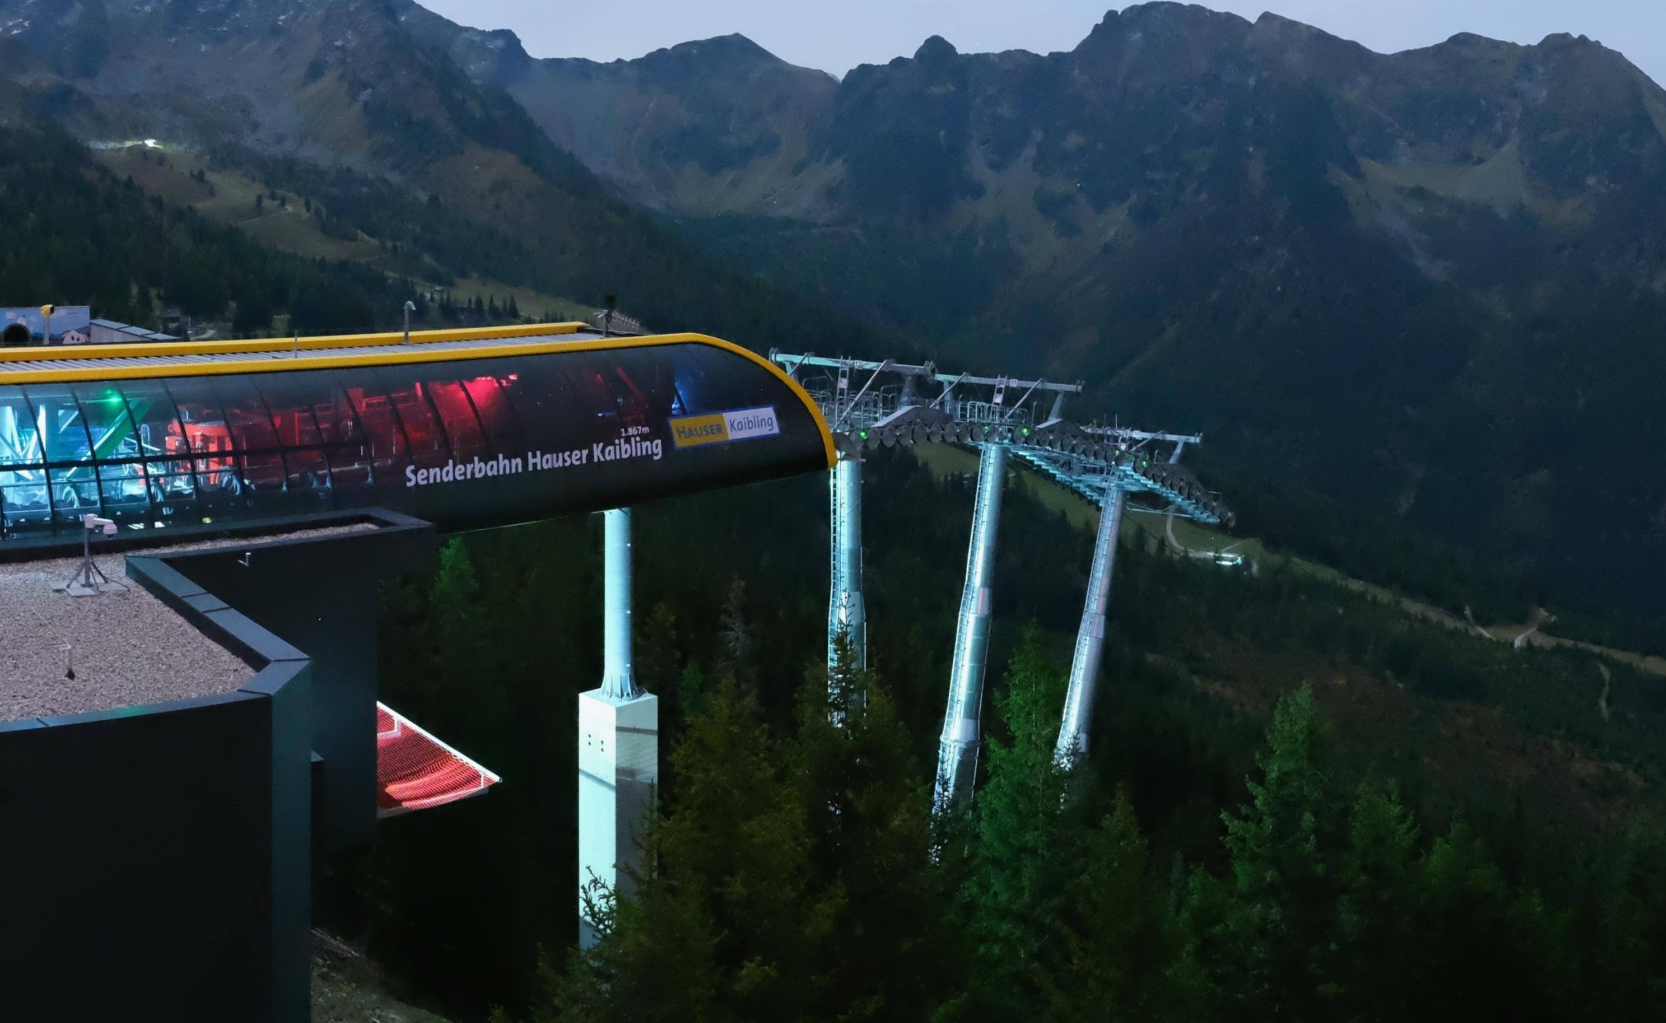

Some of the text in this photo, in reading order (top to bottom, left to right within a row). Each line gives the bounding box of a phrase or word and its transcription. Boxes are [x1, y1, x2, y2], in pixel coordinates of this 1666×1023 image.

[620, 425, 650, 437] 1.867m
[676, 415, 774, 439] HAUSER Kaibling
[405, 436, 663, 487] Senderbahn Hauser Kaibling
